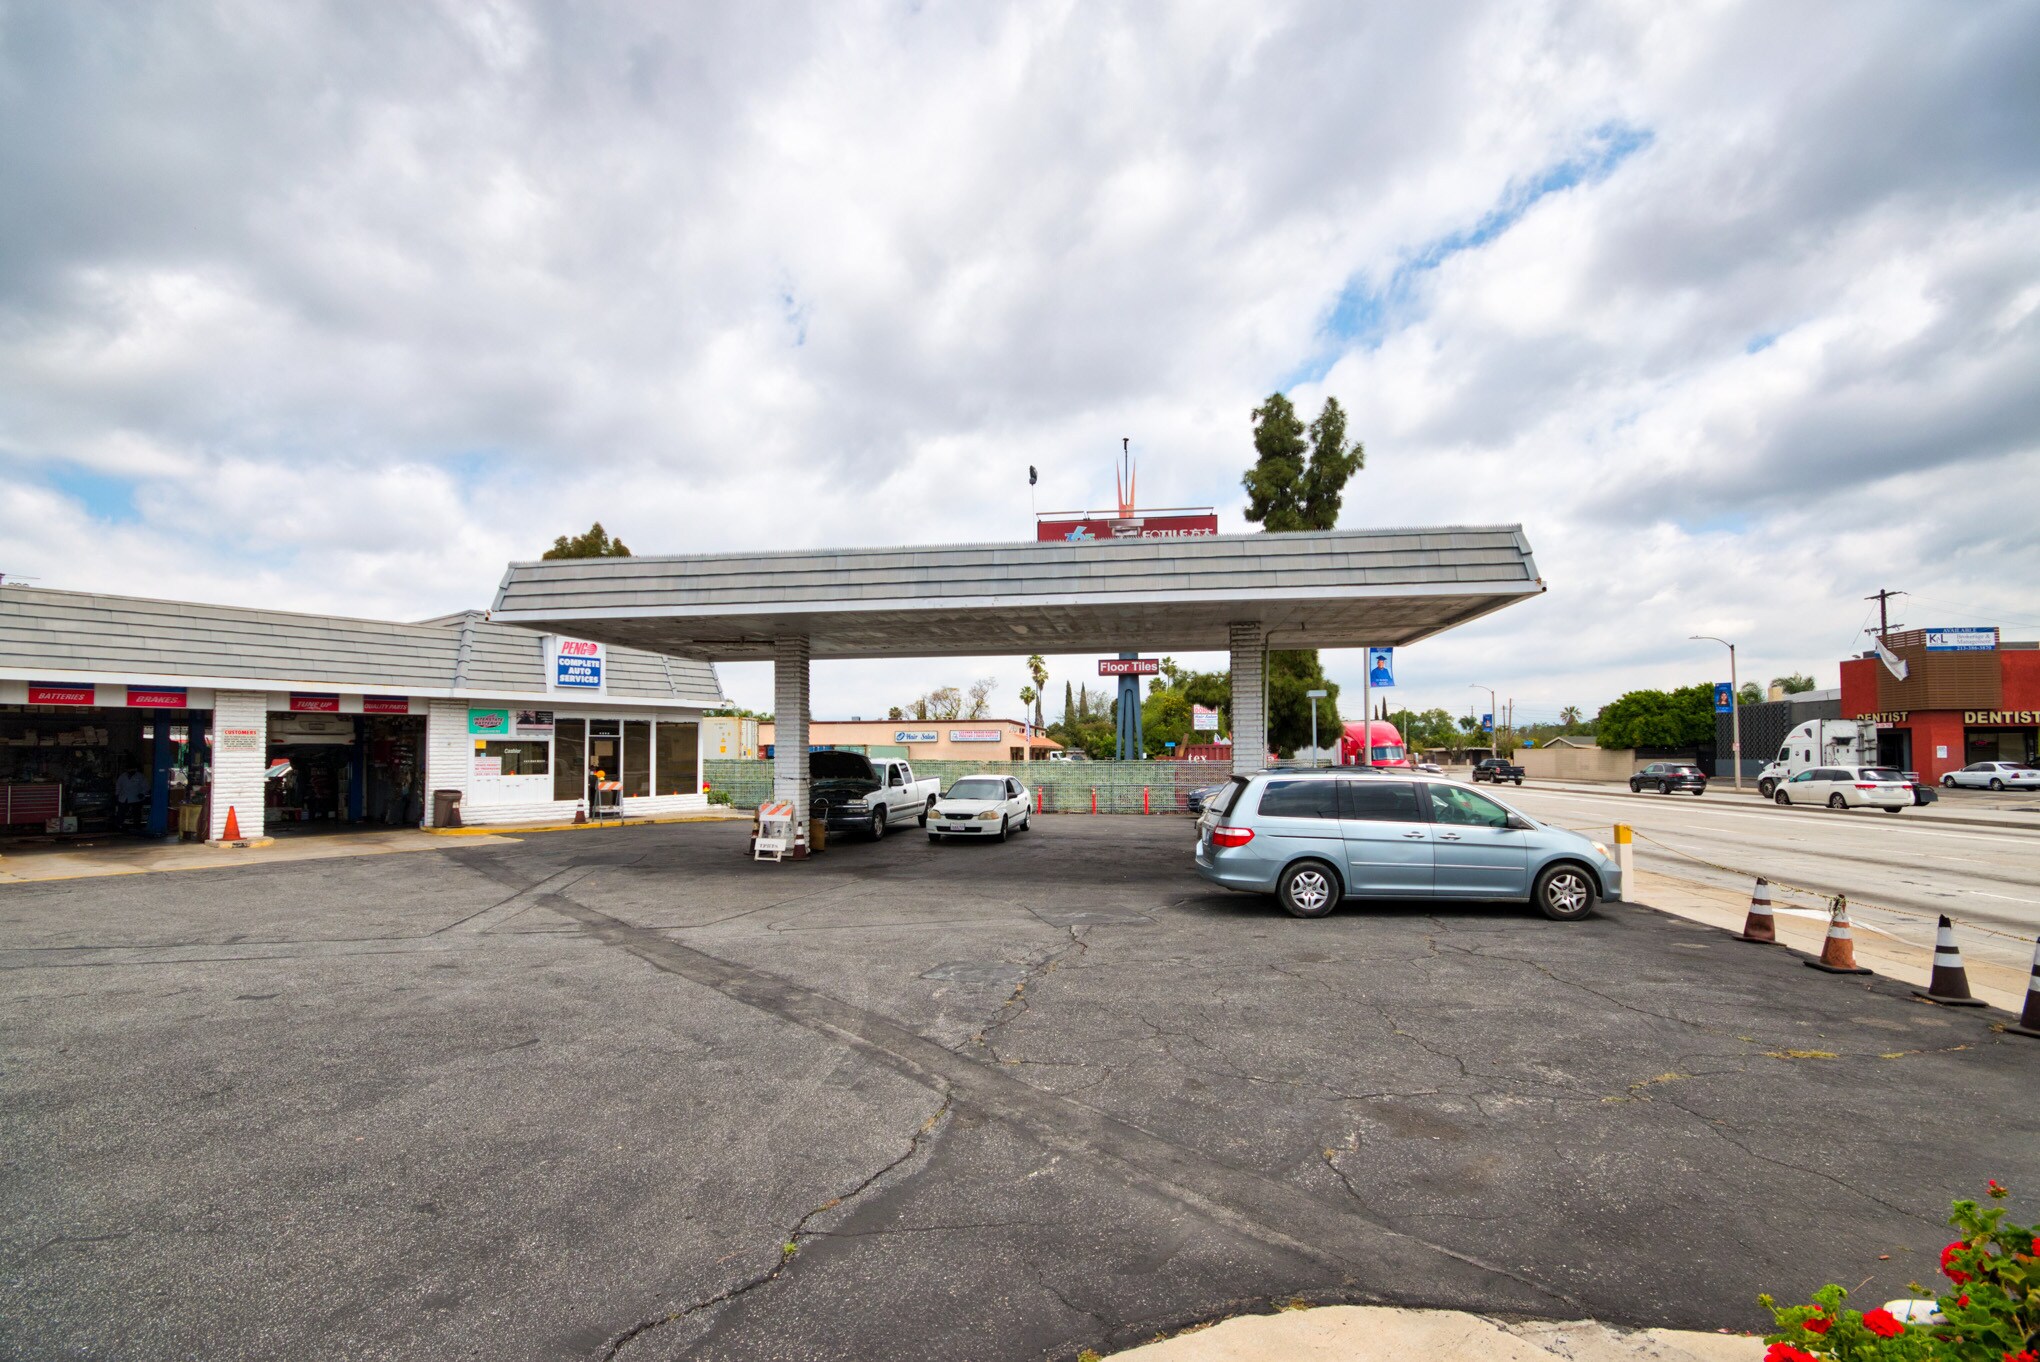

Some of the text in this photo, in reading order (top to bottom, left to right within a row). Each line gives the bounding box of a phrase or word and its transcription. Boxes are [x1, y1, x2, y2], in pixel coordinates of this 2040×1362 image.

[558, 658, 600, 668] COMPLETE
[1100, 661, 1158, 672] Floor Tiles
[568, 666, 592, 675] AUTO
[559, 674, 599, 683] SERVICES
[38, 692, 85, 701] BATTERIES
[135, 695, 178, 704] BRAKES
[1857, 711, 1909, 723] DENTIST
[1964, 711, 2040, 724] DENTIST
[906, 732, 936, 740] Hair Salon
